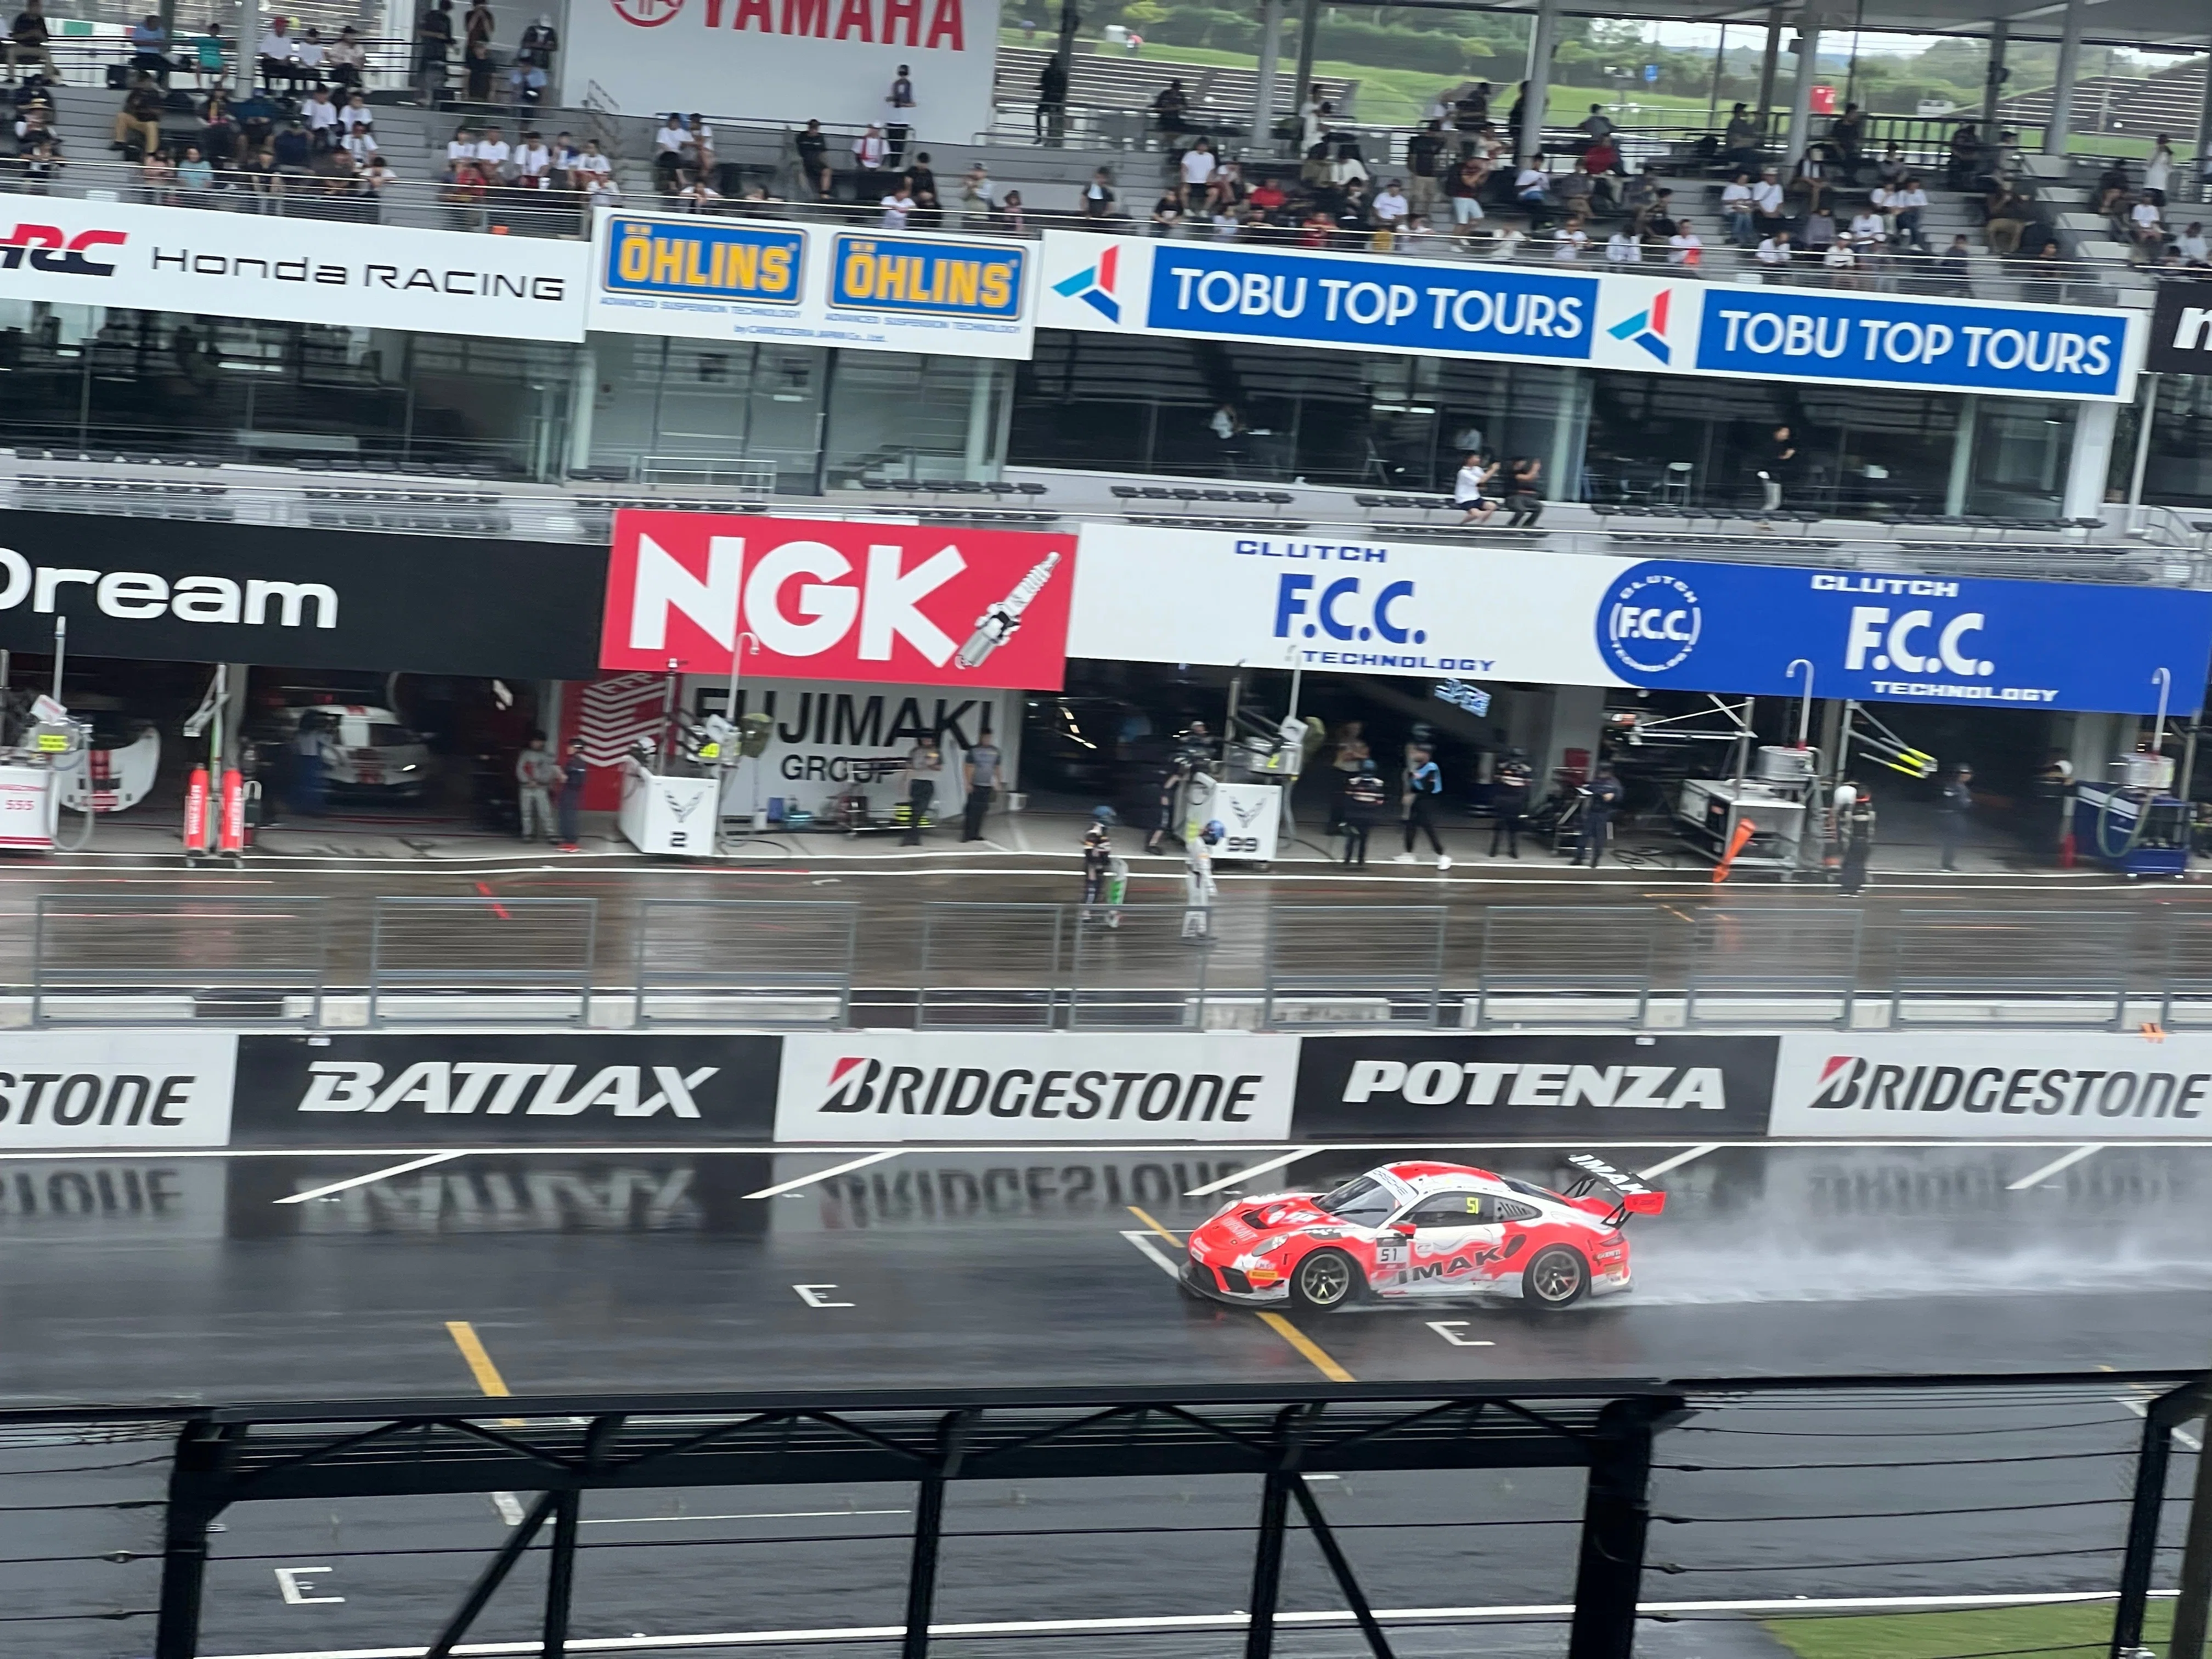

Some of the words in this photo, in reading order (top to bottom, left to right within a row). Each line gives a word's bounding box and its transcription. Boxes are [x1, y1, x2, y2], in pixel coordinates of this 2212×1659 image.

[153, 246, 347, 285] Honda
[363, 263, 566, 302] RACING
[618, 224, 792, 292] ÖHLINS
[843, 241, 1013, 308] ÖHLINS
[1171, 267, 1307, 318] TOBU
[1318, 279, 1418, 326] TOP
[1426, 287, 1582, 338] TOURS
[1719, 309, 1849, 358] TOBU
[1859, 319, 1953, 364] TOP
[1961, 326, 2112, 375] TOURS
[1234, 540, 1387, 563] CLUTCH
[629, 532, 968, 668] NGK
[1274, 573, 1426, 644] F.C.C.
[1811, 574, 1960, 598] CLUTCH
[1302, 650, 1496, 672] TECHNOLOGY
[1844, 606, 1995, 676] F.C.C.
[1870, 680, 2060, 702] TECHNOLOGY
[781, 754, 893, 784] GROU
[670, 831, 688, 847] 2
[297, 1061, 720, 1118] BATTLAX
[817, 1057, 1263, 1122] BRIDGESTONE
[1342, 1060, 1725, 1109] POTENZA
[1809, 1056, 2212, 1119] BRIDGESTONE
[1466, 1197, 1479, 1214] 51
[1380, 1248, 1397, 1261] 51
